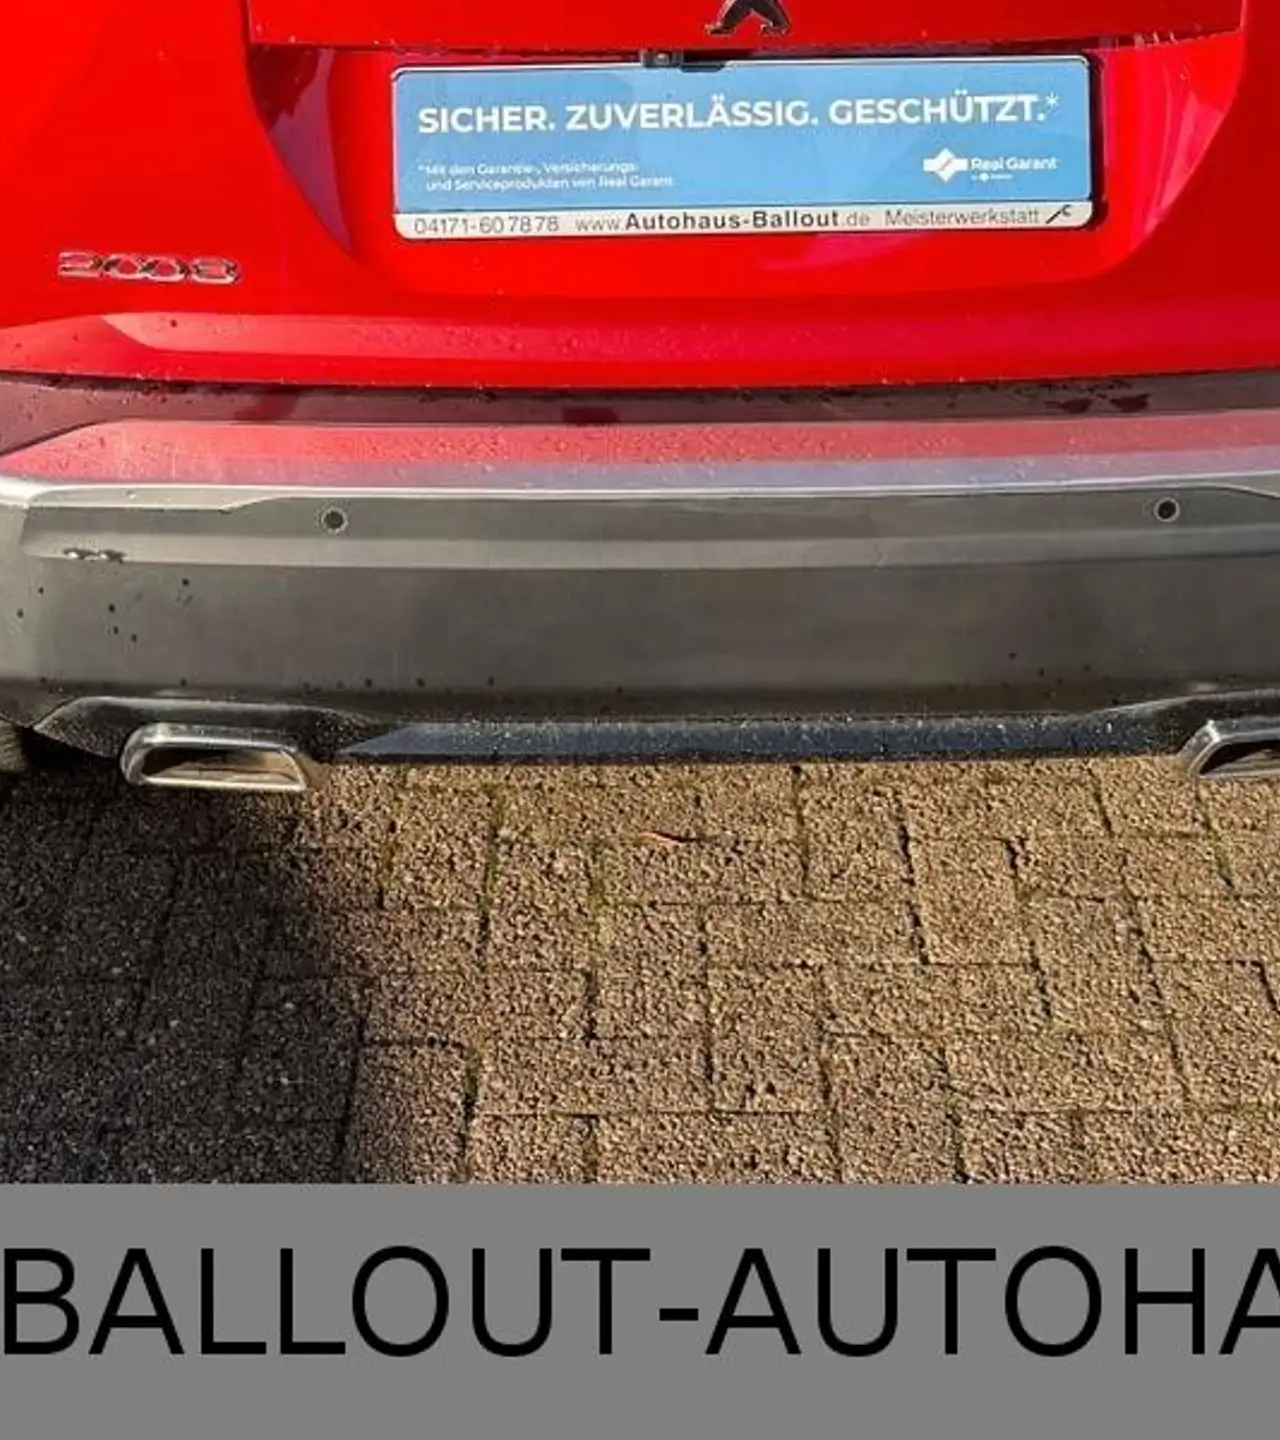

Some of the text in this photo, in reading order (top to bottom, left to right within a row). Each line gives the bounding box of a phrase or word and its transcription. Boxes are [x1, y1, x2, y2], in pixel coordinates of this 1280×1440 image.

[418, 105, 556, 134] SICHER.
[565, 93, 820, 131] ZUVERLÄSSIG.
[971, 156, 1059, 171] Real Garant
[426, 177, 452, 192] und
[884, 206, 1041, 228] Meisterwerkstatt
[57, 251, 240, 285] 2008
